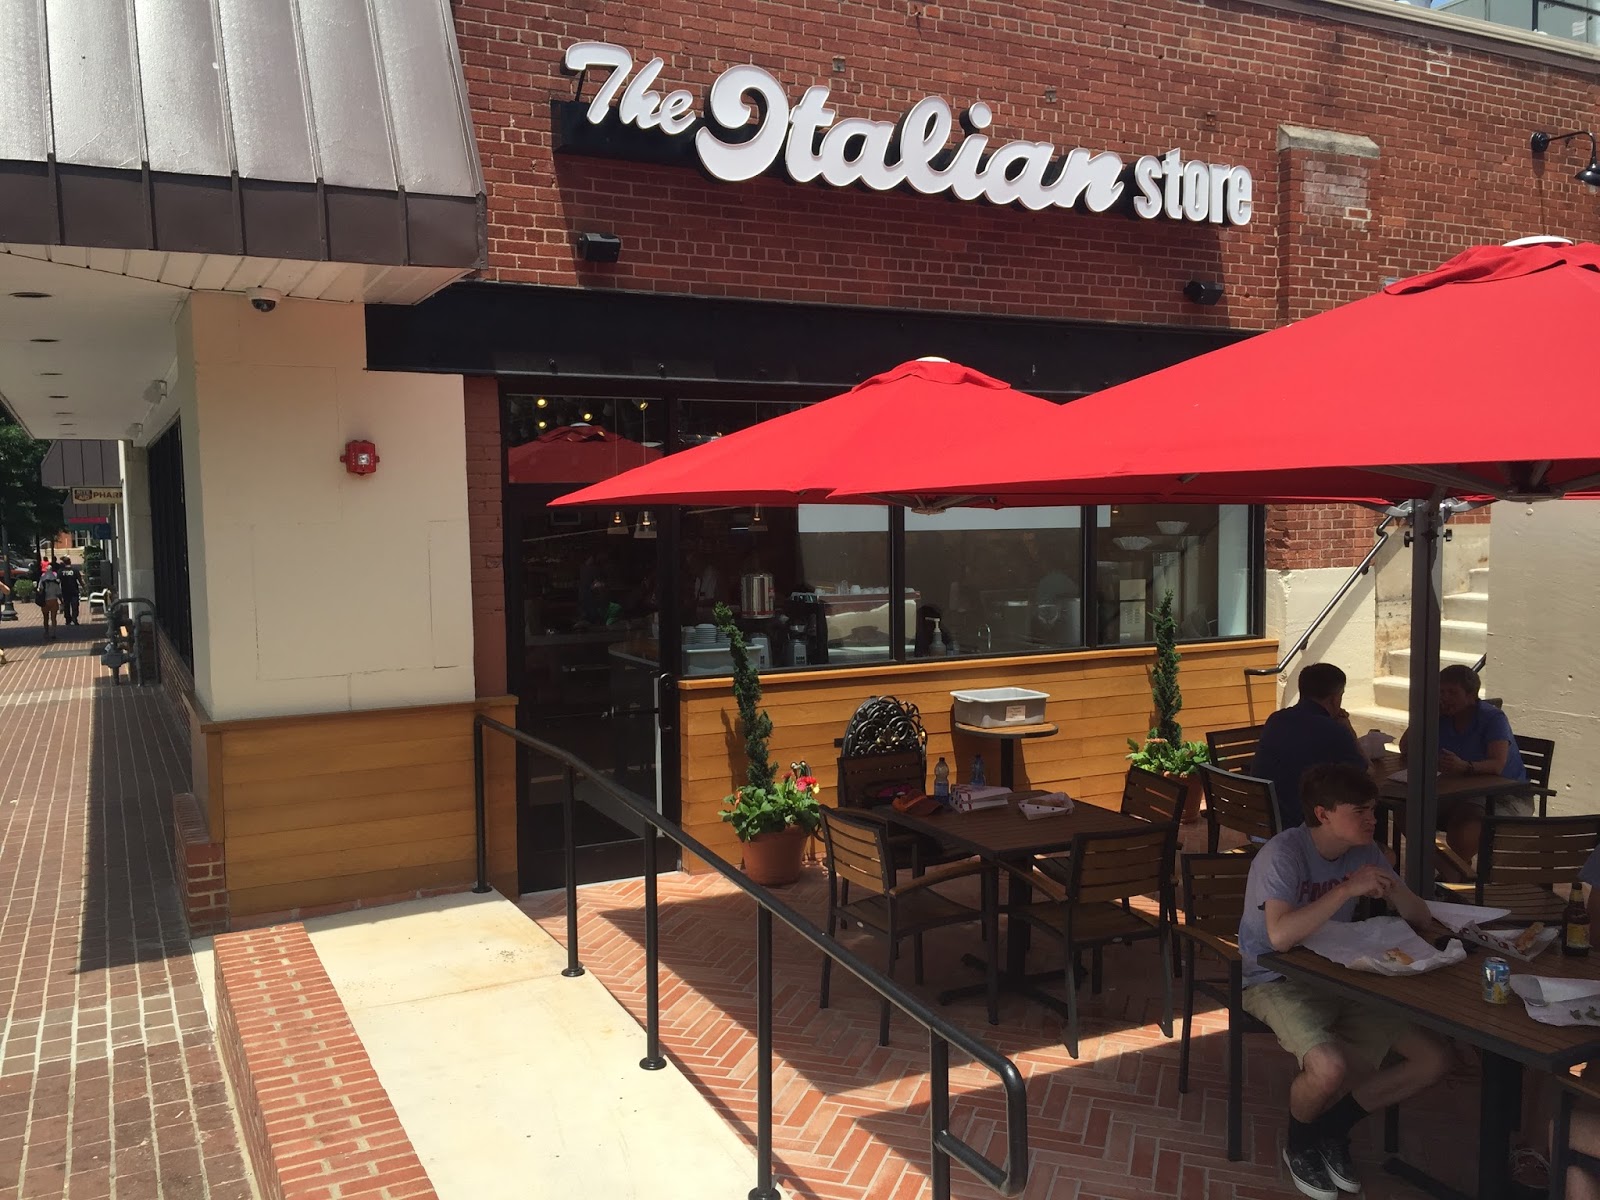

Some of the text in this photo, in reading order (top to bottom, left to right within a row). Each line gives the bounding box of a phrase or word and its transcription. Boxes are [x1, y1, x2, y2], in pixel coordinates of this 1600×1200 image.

[566, 41, 1252, 226] The Italian store
